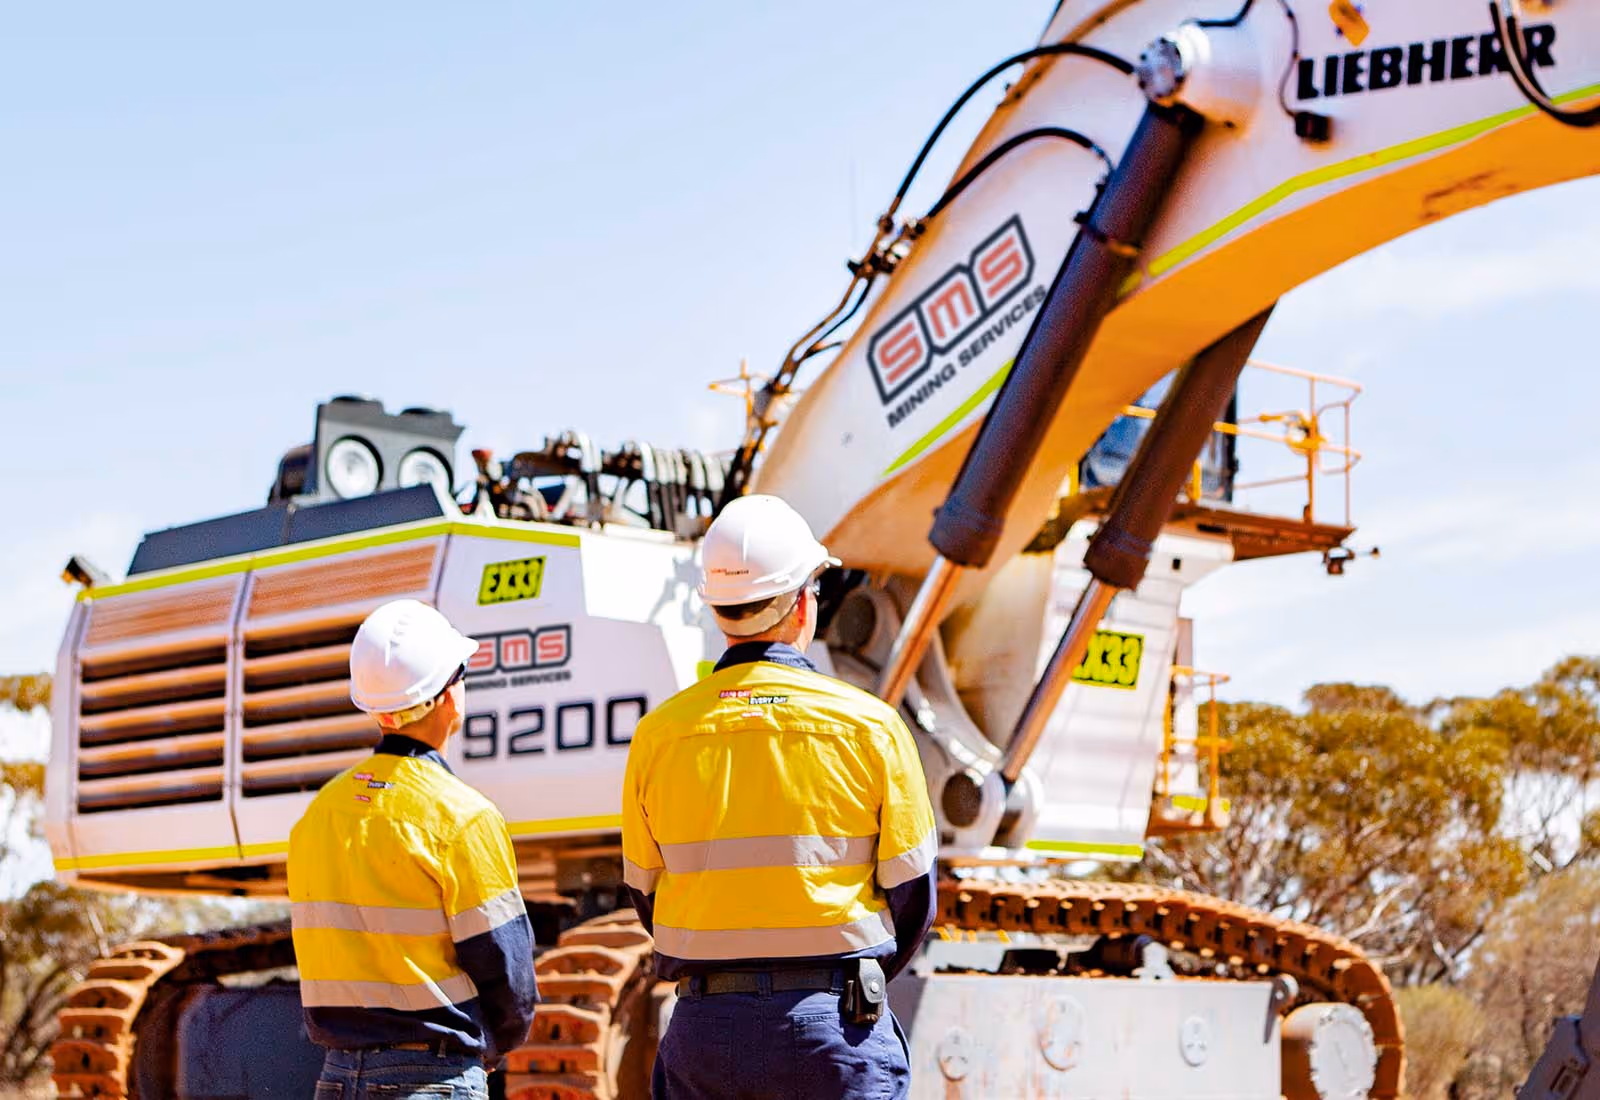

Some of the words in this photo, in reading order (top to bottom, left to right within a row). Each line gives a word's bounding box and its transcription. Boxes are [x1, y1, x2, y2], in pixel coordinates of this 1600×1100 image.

[1297, 24, 1556, 101] LIEBHERR
[886, 364, 957, 428] MINING
[958, 285, 1046, 368] SERVICES
[510, 670, 572, 687] SERVICES
[463, 696, 647, 760] 9200
